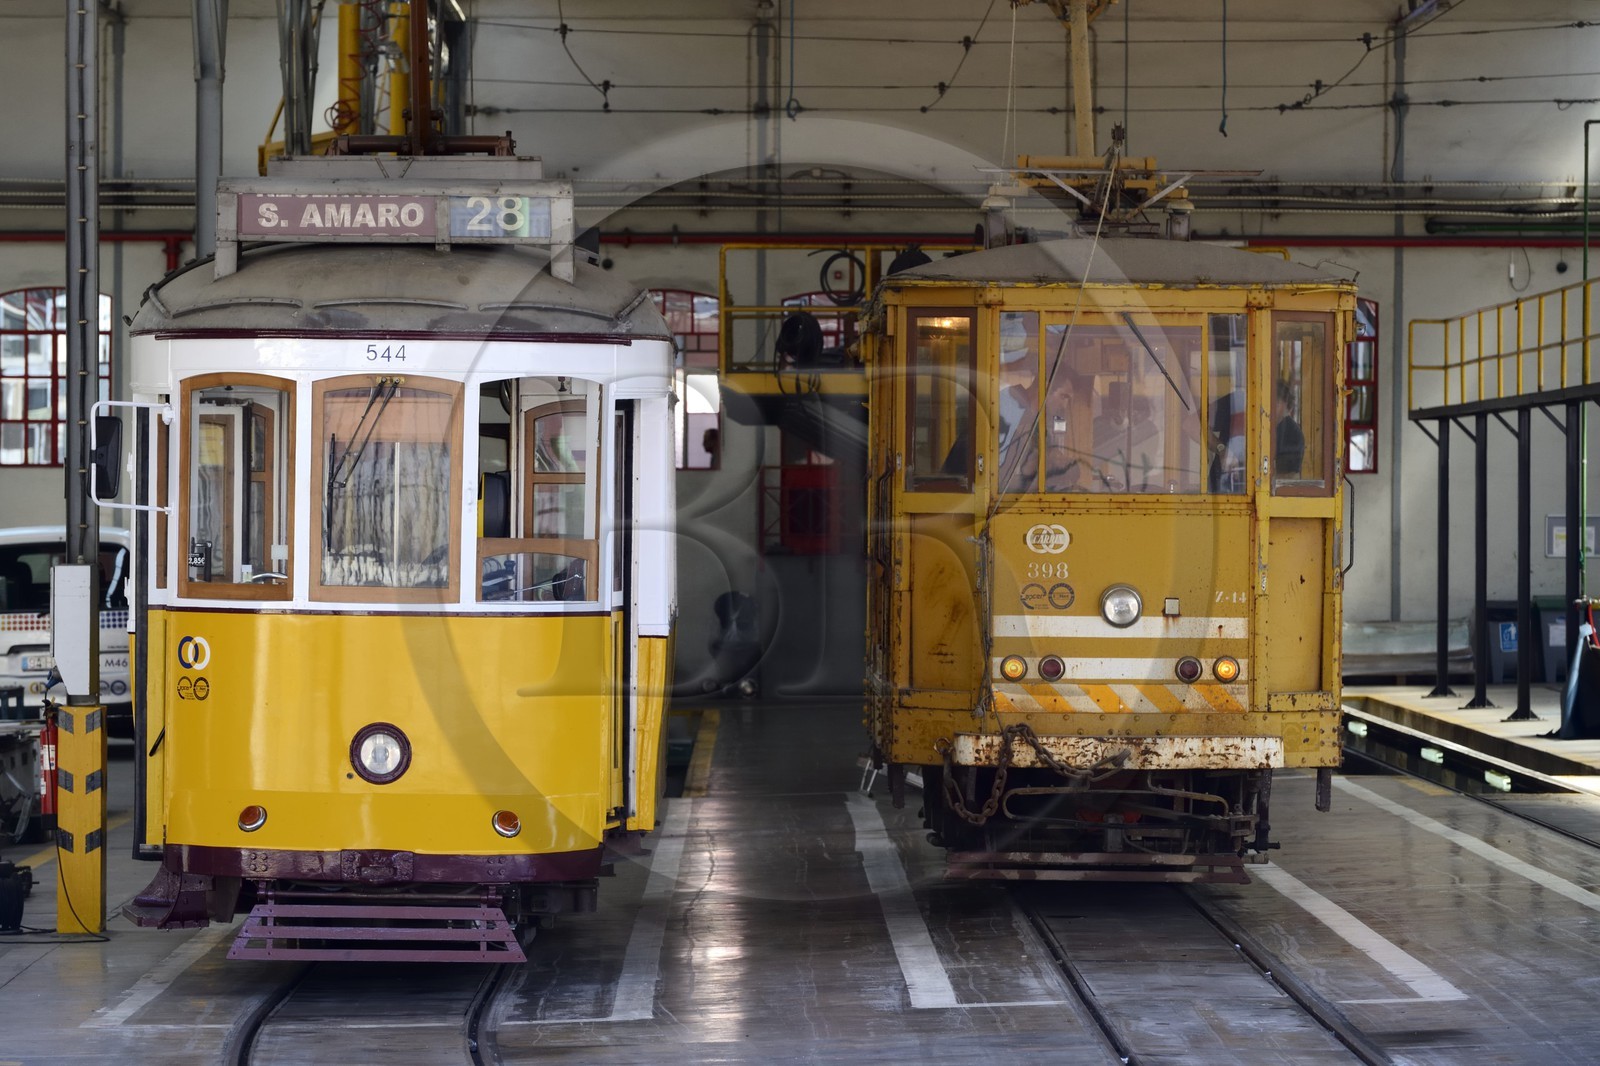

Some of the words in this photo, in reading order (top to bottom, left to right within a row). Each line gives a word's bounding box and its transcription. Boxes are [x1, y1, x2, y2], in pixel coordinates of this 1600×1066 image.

[258, 202, 288, 228] S.
[299, 202, 425, 228] AMARO
[466, 196, 525, 231] 28
[366, 344, 407, 362] 544
[1027, 561, 1069, 579] 398
[104, 659, 128, 668] M46
